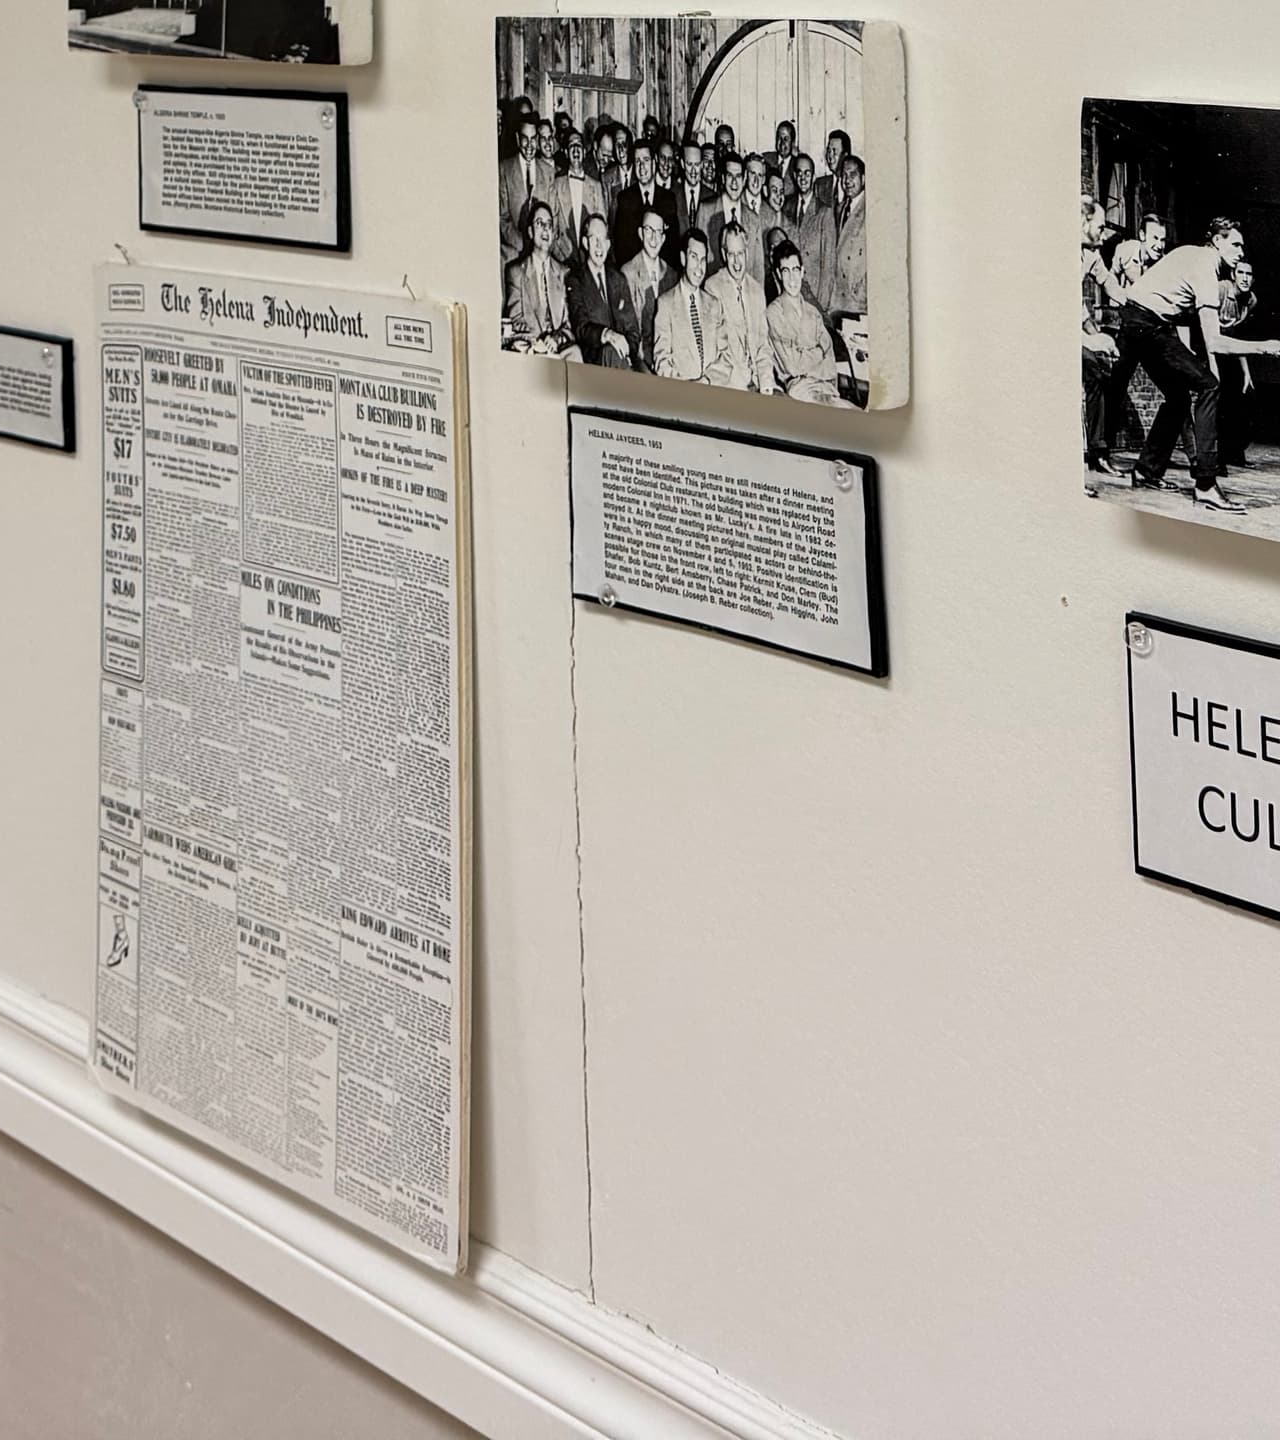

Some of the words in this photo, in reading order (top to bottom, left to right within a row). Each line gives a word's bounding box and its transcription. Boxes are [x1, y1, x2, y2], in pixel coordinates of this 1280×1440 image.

[161, 283, 191, 313] The
[199, 286, 255, 326] Helena
[263, 295, 369, 339] Independent.
[339, 377, 377, 401] MONTANA
[378, 384, 399, 405] CLUB
[400, 388, 437, 411] BUILDING
[356, 403, 365, 420] IS
[367, 405, 413, 430] DESTROYED
[416, 413, 427, 433] BY
[431, 417, 447, 438] FIRE
